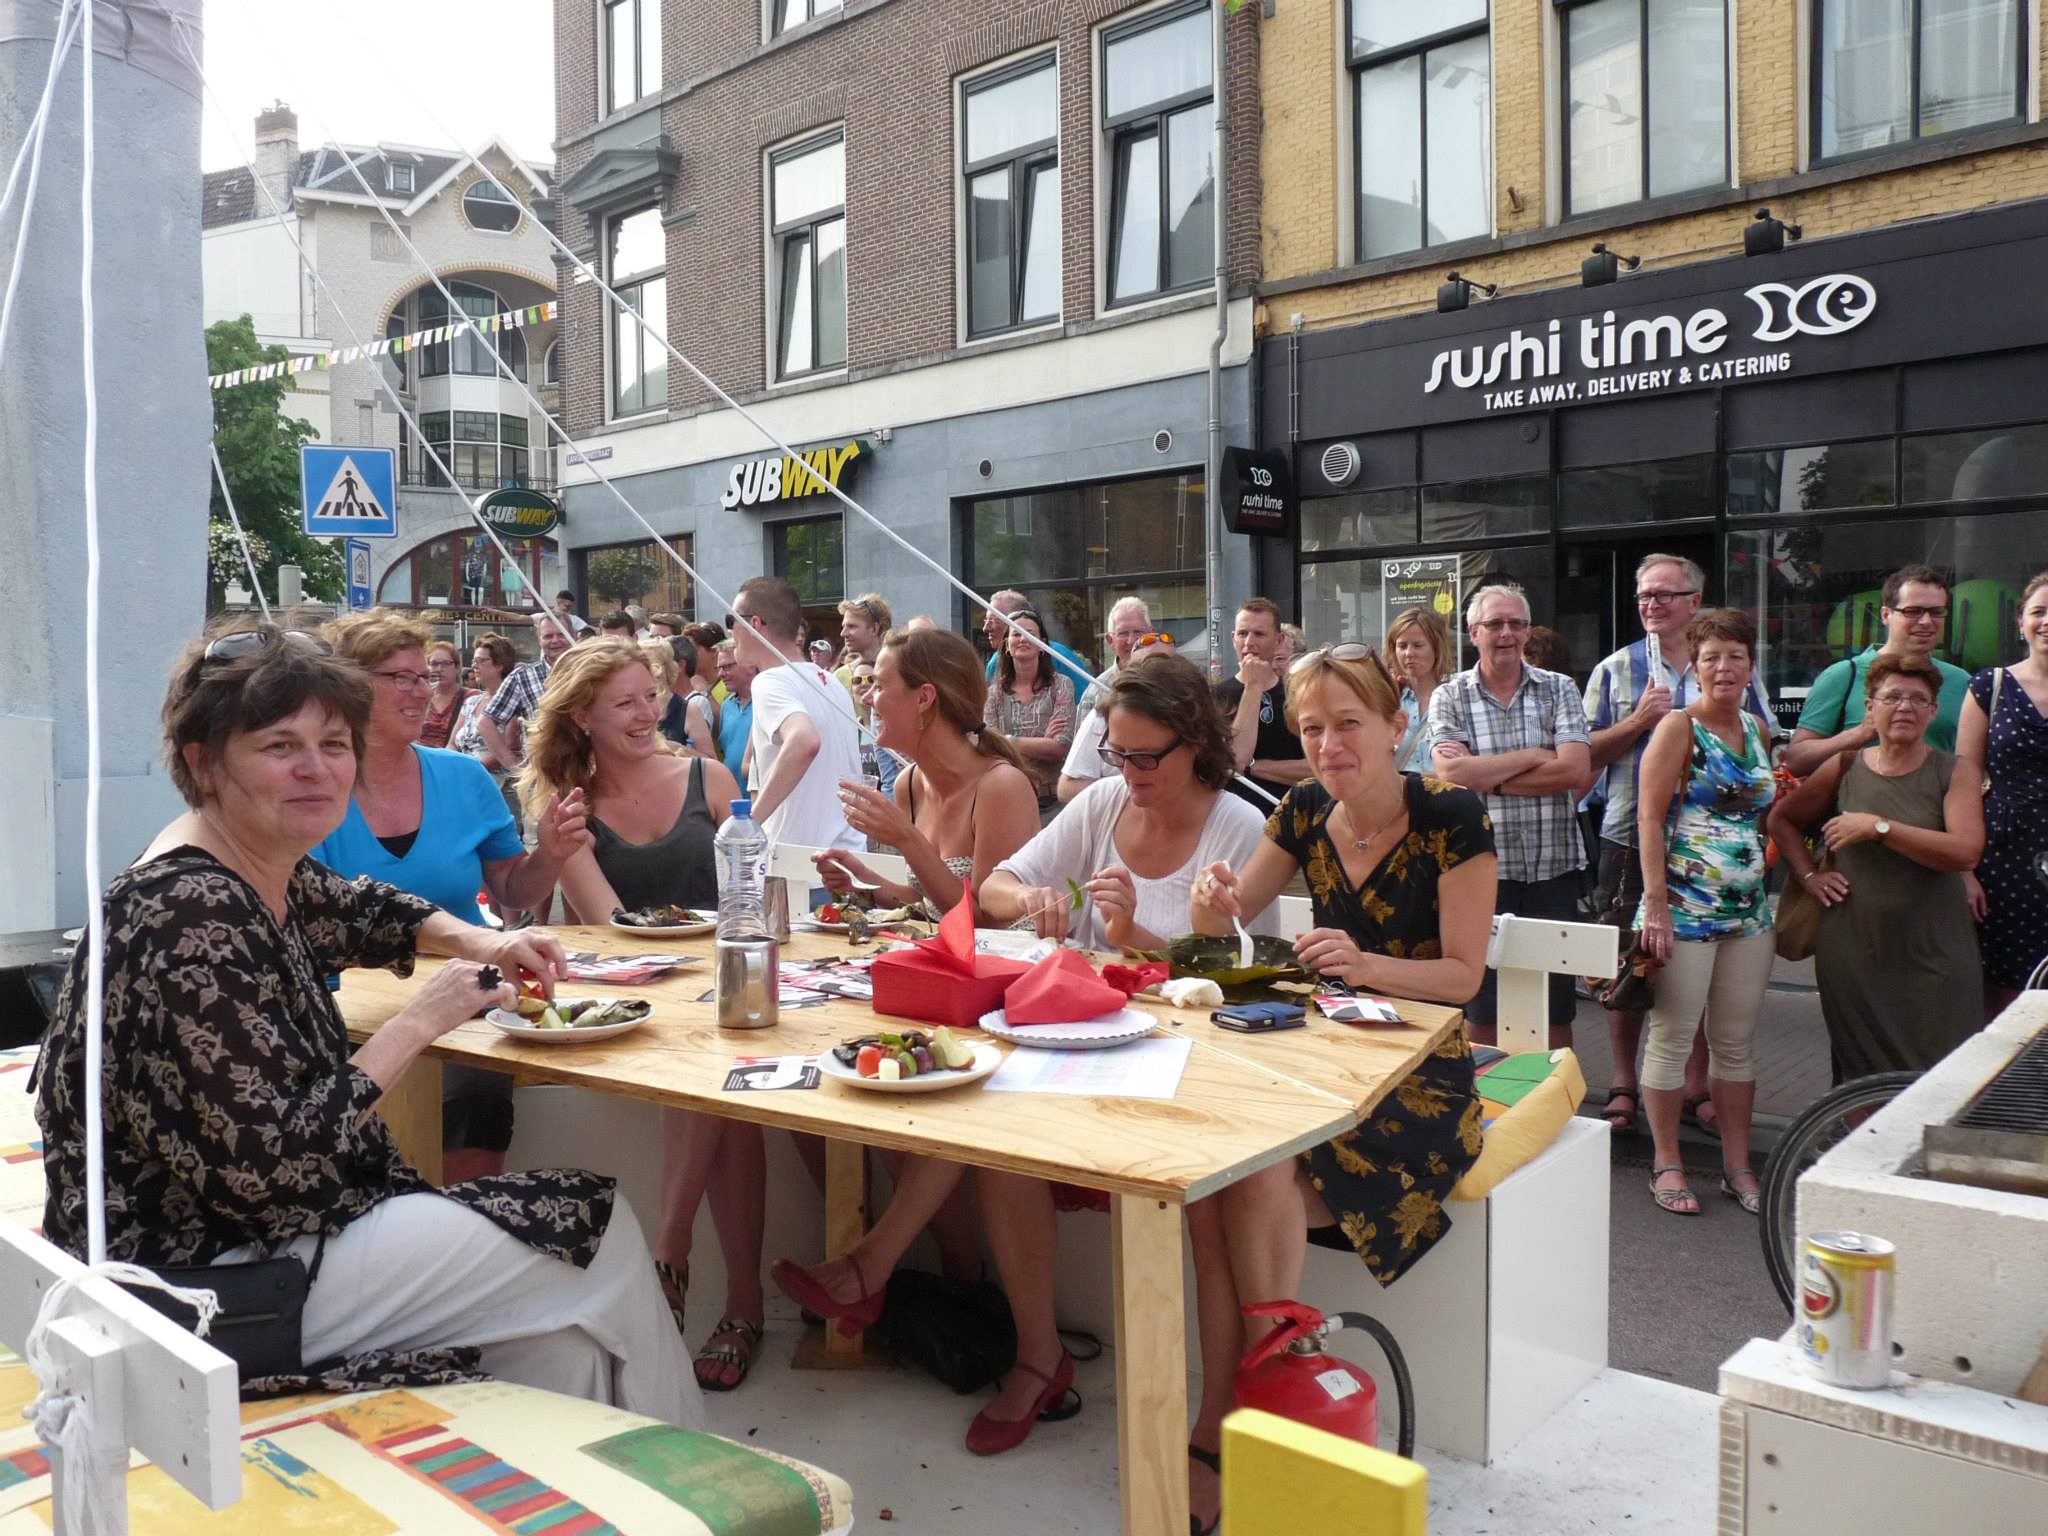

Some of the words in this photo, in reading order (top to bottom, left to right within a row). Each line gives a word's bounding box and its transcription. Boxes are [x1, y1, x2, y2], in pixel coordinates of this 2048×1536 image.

[1424, 319, 1561, 393] sushi
[1580, 308, 1728, 369] time
[1484, 389, 1524, 411] TAKE
[1529, 382, 1583, 405] AWAY,
[1588, 368, 1672, 397] DELIVERY
[1678, 366, 1692, 384] &
[1699, 352, 1791, 382] CATERING
[720, 439, 861, 512] SUBWAY
[1242, 493, 1263, 508] sushi
[1264, 494, 1283, 510] time
[483, 504, 556, 526] SUBWAY
